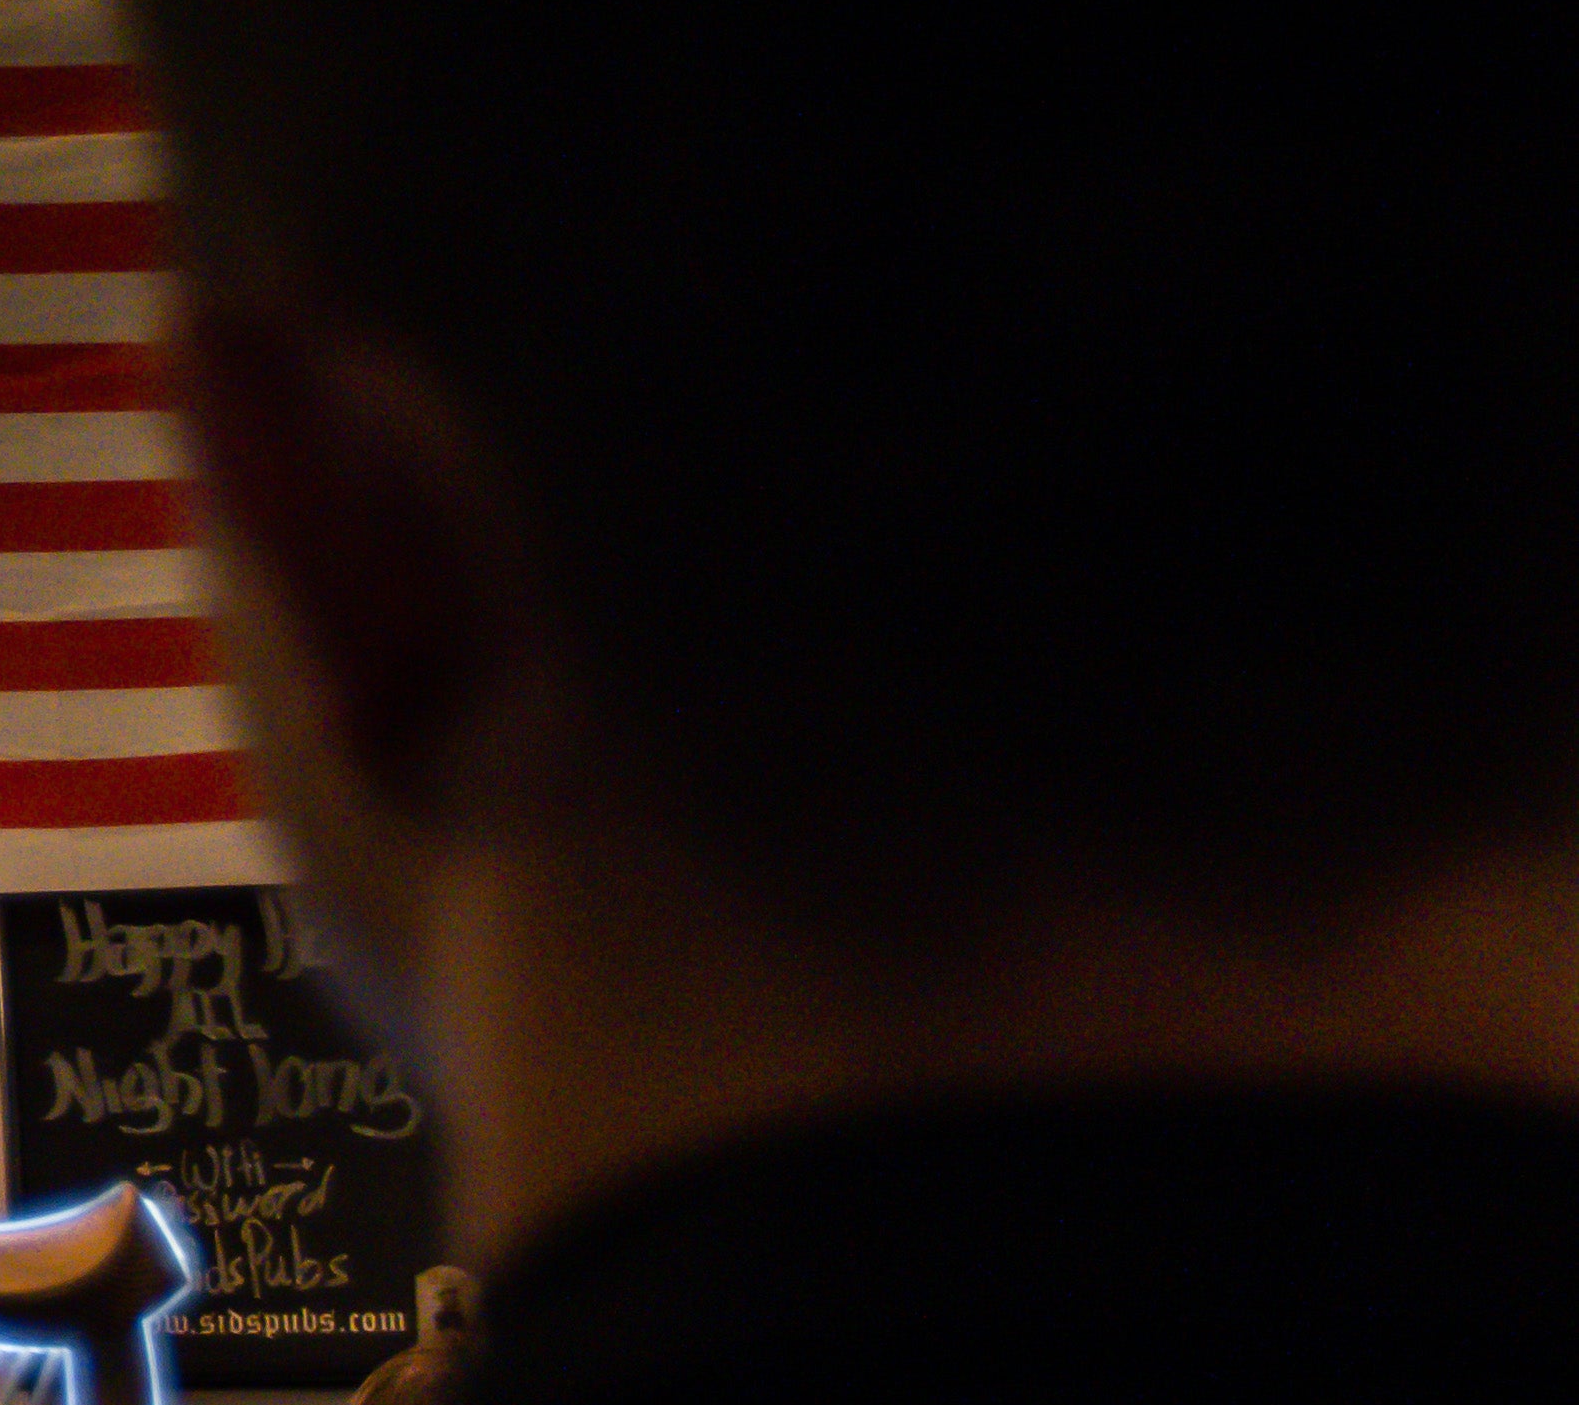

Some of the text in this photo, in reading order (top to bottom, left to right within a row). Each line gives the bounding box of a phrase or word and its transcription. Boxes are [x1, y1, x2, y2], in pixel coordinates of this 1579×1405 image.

[57, 898, 243, 998] Happy
[42, 1038, 227, 1136] Night
[152, 1163, 336, 1227] ssword
[197, 1216, 350, 1301] dsPubs
[155, 1307, 407, 1339] w.sidspubs.com
